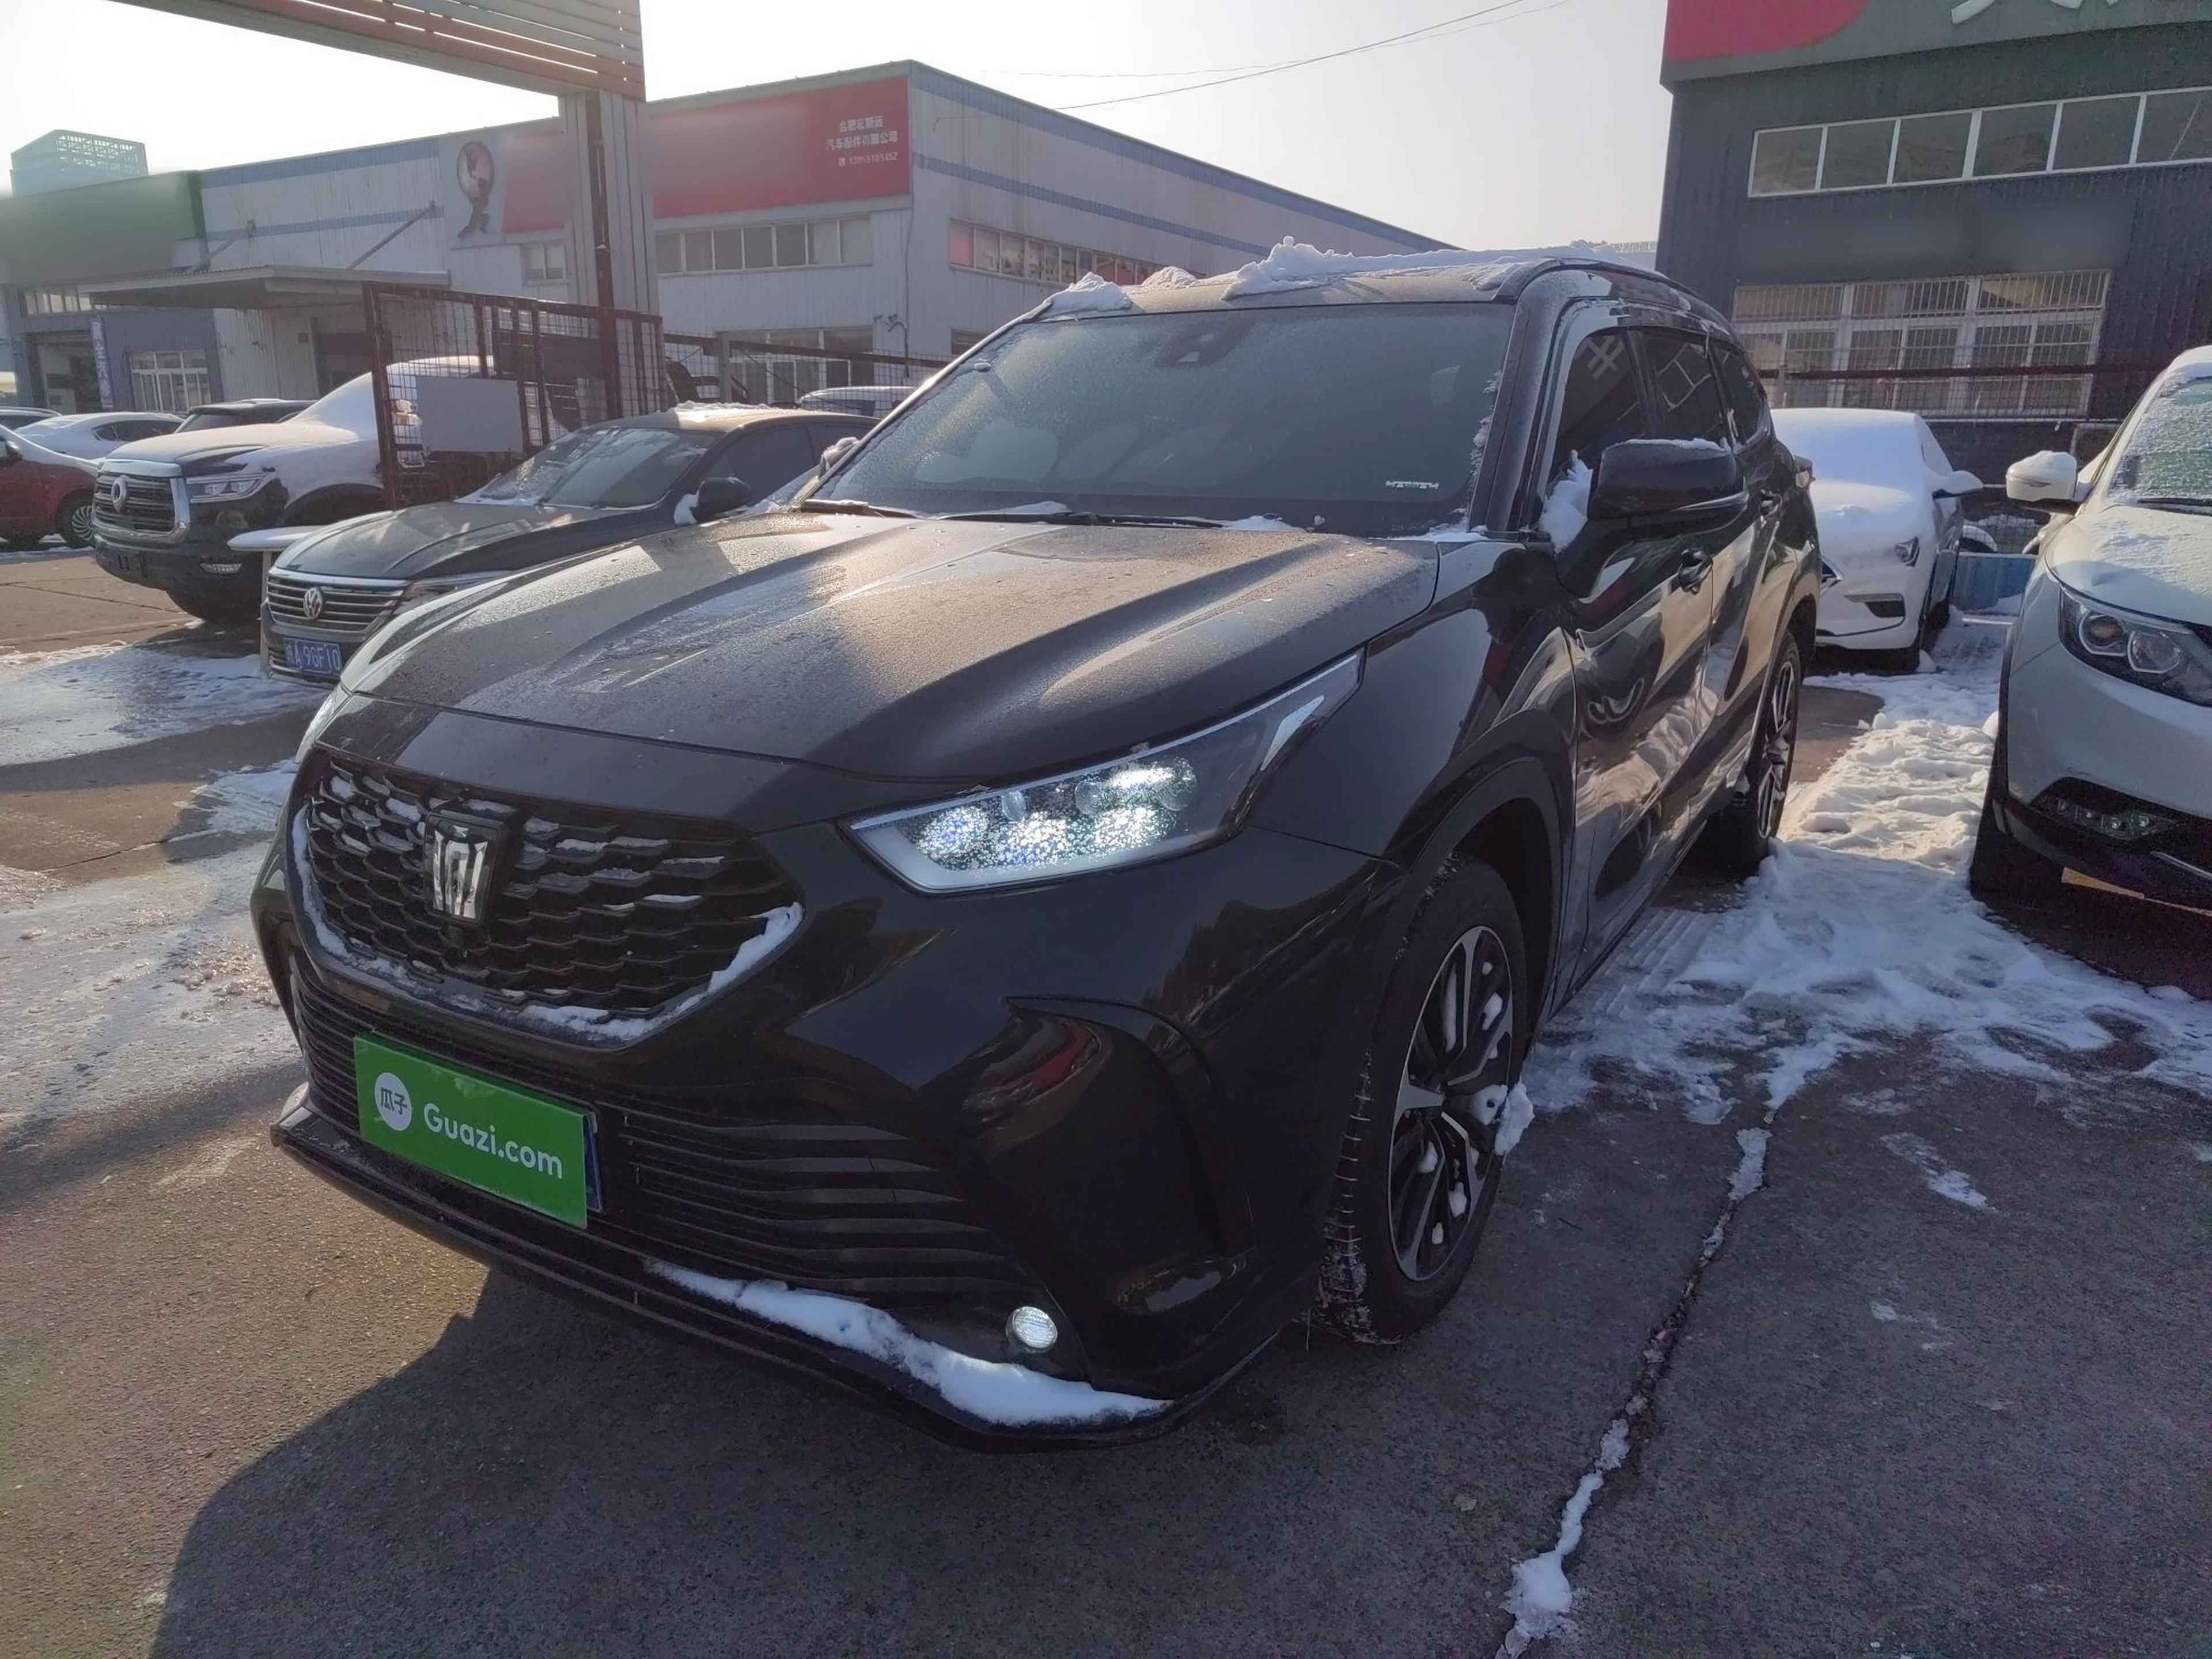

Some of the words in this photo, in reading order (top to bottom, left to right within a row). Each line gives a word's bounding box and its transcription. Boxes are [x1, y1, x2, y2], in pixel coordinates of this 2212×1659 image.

[828, 131, 897, 150] 汽车配件有限公司
[380, 1086, 407, 1115] 瓜子
[423, 1103, 563, 1179] Guazi.com
